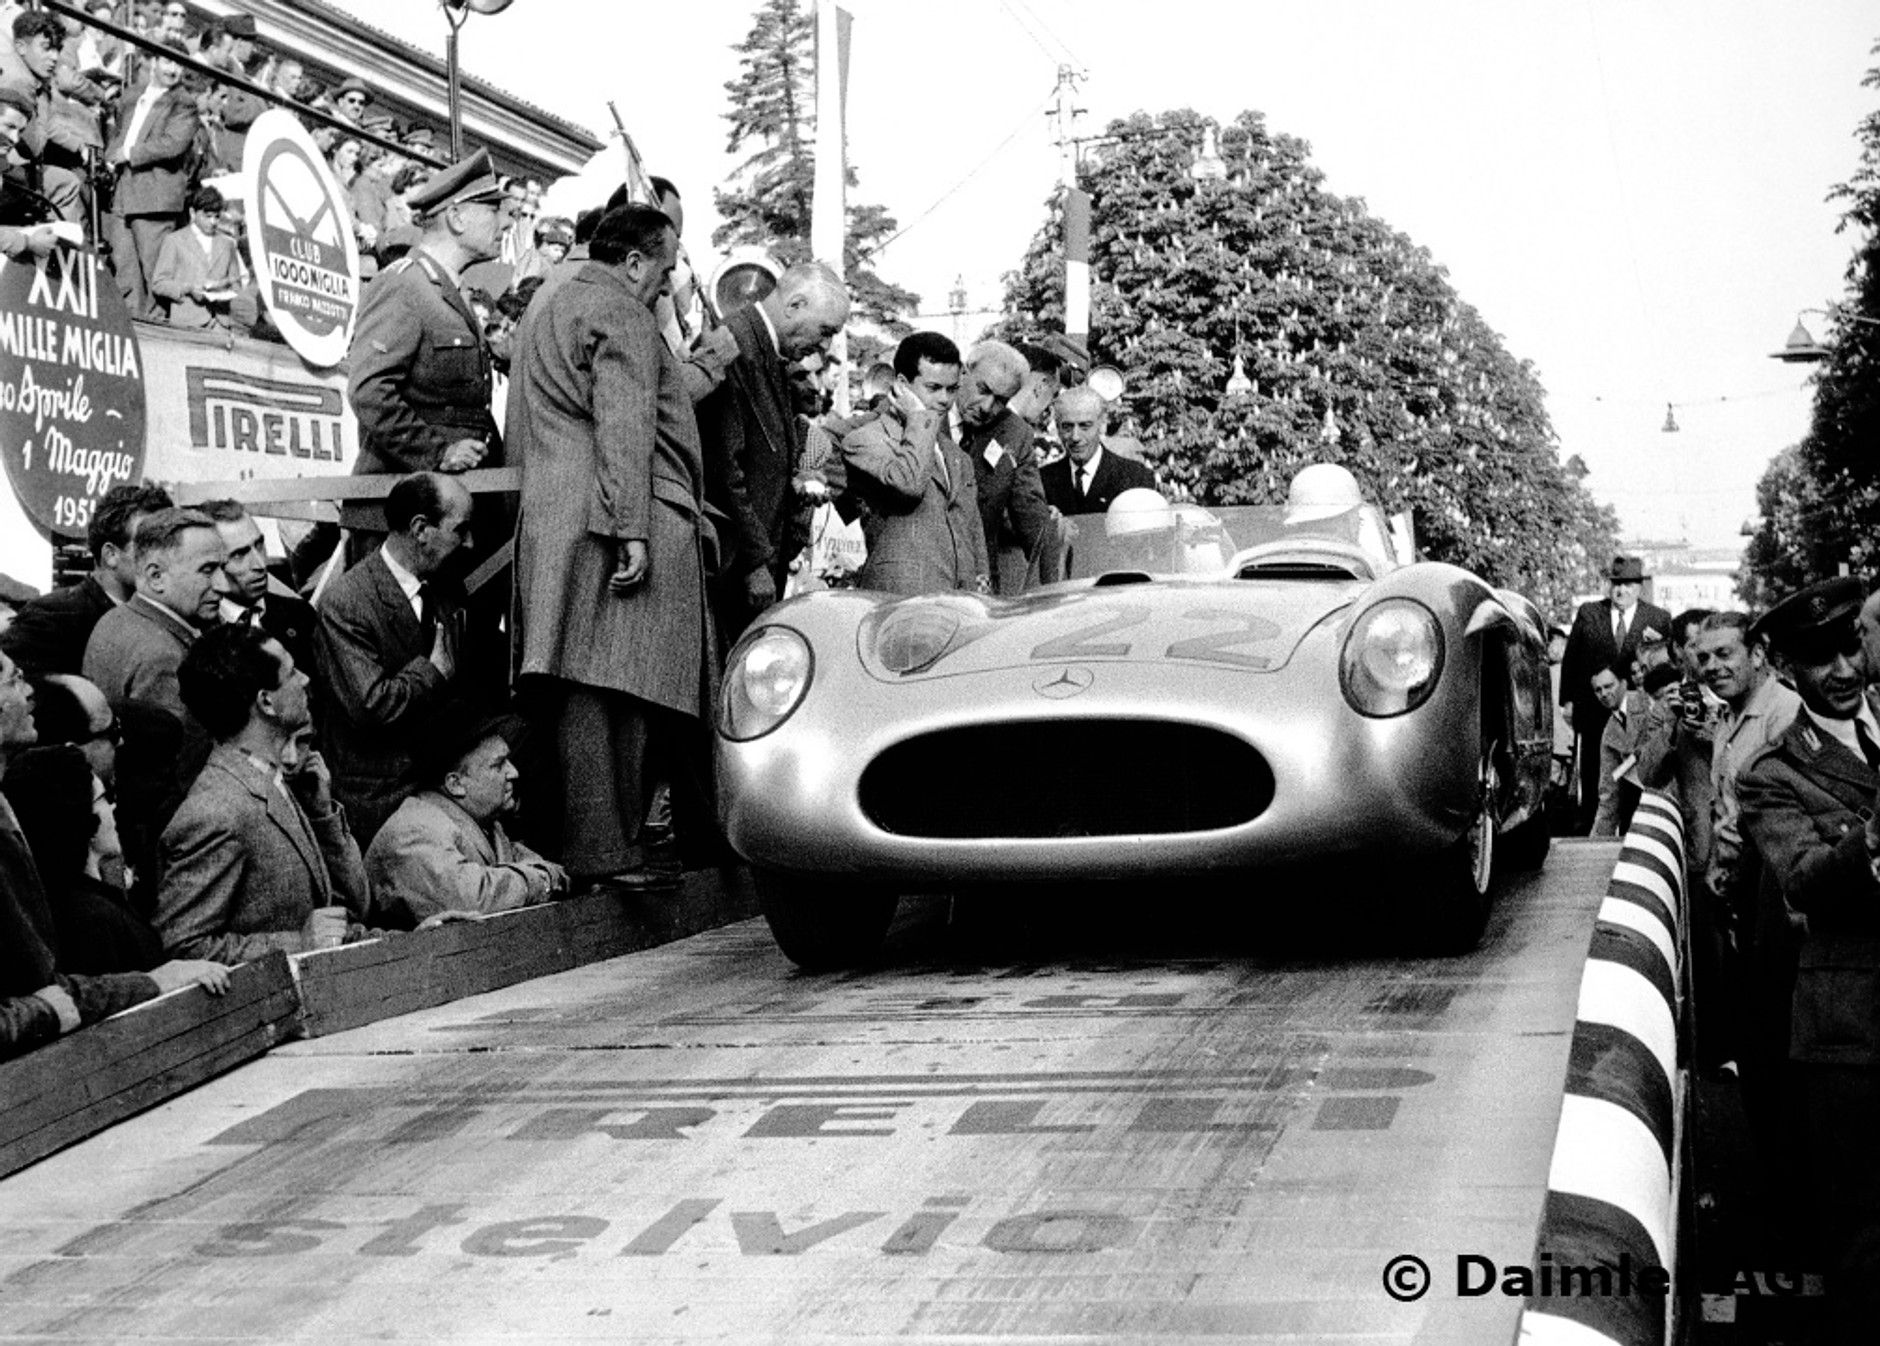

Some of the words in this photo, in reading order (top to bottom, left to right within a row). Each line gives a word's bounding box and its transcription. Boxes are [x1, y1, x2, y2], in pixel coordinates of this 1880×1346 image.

[290, 236, 321, 264] CLUB
[278, 287, 310, 308] FRANCO
[0, 310, 57, 363] MILLE
[62, 324, 139, 379] MIGLIA
[17, 364, 93, 433] Aprile
[185, 365, 343, 462] PIRELLI
[22, 439, 32, 470] 1
[44, 425, 134, 496] Maggio
[1030, 606, 1283, 669] 22
[202, 1066, 1436, 1146] PIRELLI
[194, 1196, 1134, 1257] stelvio
